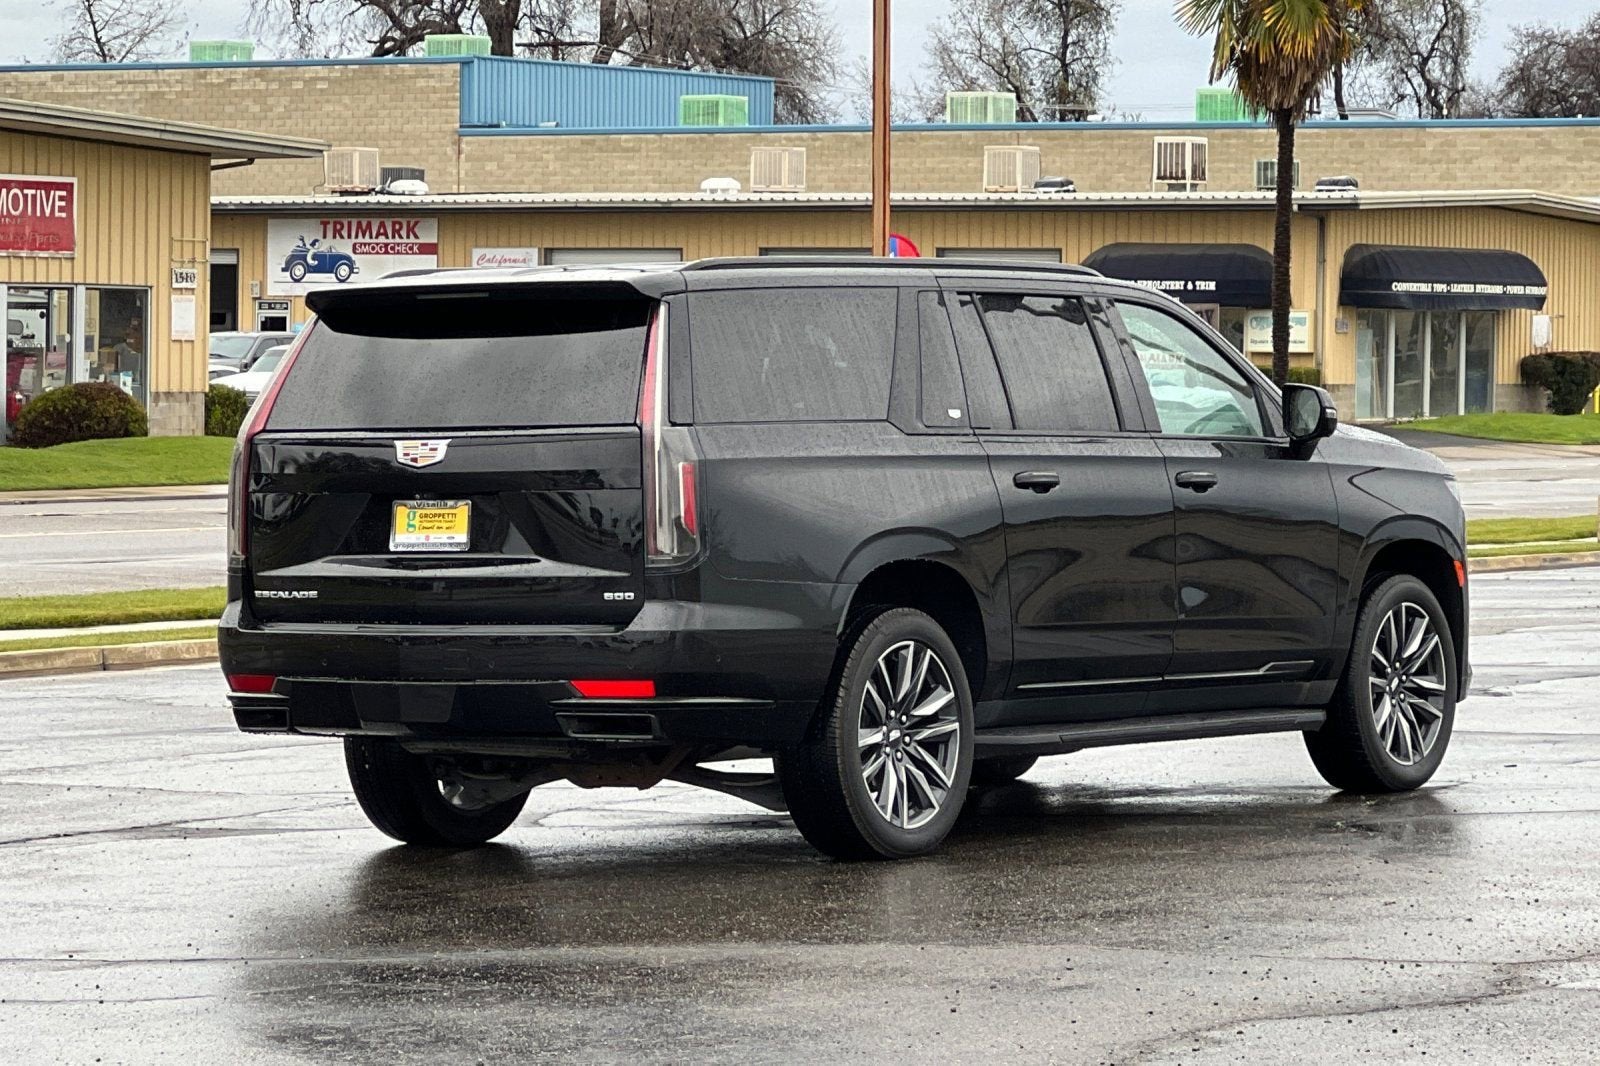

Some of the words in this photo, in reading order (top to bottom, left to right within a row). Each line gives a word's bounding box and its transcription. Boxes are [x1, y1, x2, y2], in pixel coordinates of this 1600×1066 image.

[320, 219, 420, 239] TRIMARK
[355, 243, 386, 254] SMOG
[387, 243, 420, 254] CHECK
[476, 253, 528, 267] California
[1187, 280, 1194, 290] &
[1195, 281, 1216, 291] TRIM
[1433, 283, 1448, 293] TOPS
[1506, 285, 1525, 295] POWER
[254, 590, 319, 599] ESCALADE
[603, 591, 635, 601] 600
